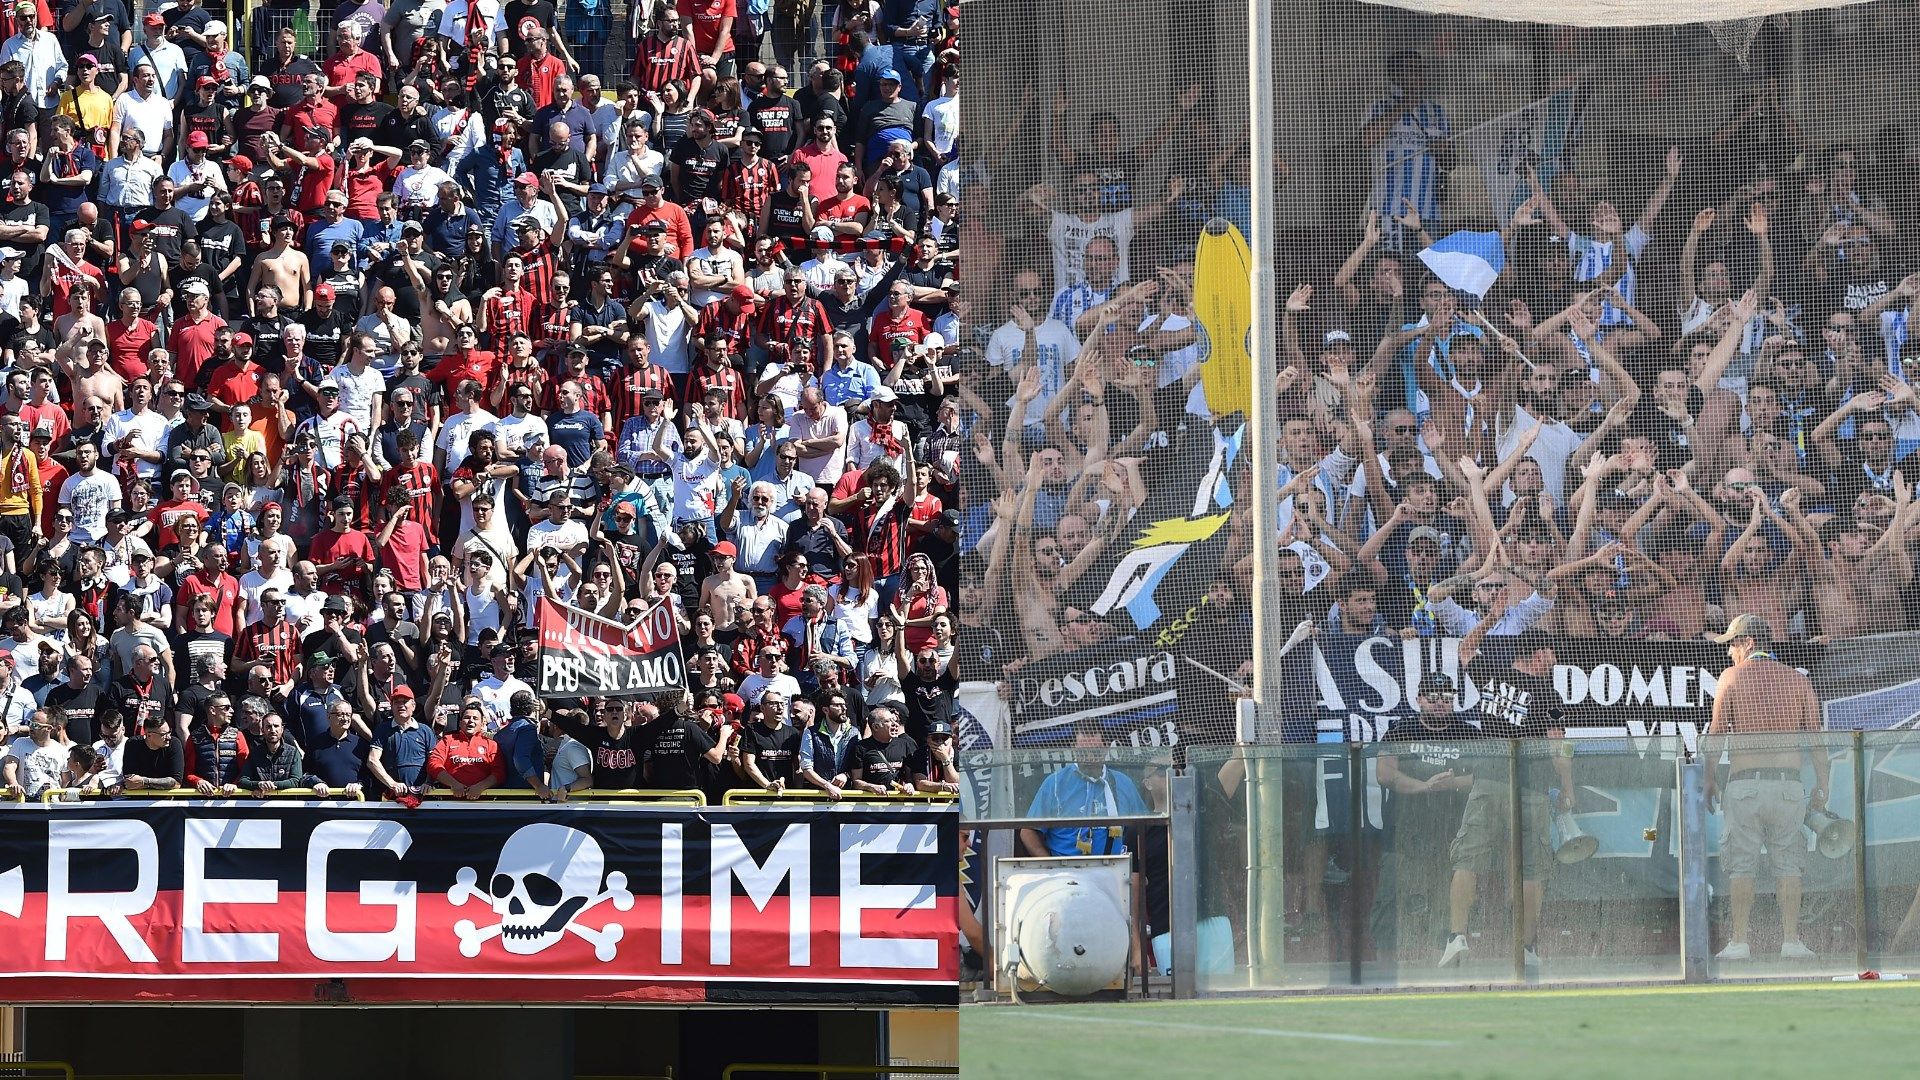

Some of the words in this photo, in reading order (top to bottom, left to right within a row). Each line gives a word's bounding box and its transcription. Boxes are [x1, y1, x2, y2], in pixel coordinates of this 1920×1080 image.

[1847, 281, 1888, 300] DALLAS
[1844, 295, 1886, 312] COWB
[882, 330, 915, 340] Tamma
[546, 535, 571, 545] FILA
[679, 567, 695, 576] SUD
[255, 642, 288, 651] Tamma
[626, 651, 681, 689] AMO
[1016, 651, 1177, 714] Pescara
[1553, 663, 1718, 708] DOMEN
[935, 723, 944, 732] B
[450, 755, 484, 764] Tamma
[597, 747, 637, 770] FOGGIA
[1409, 743, 1461, 760] ULTRAS
